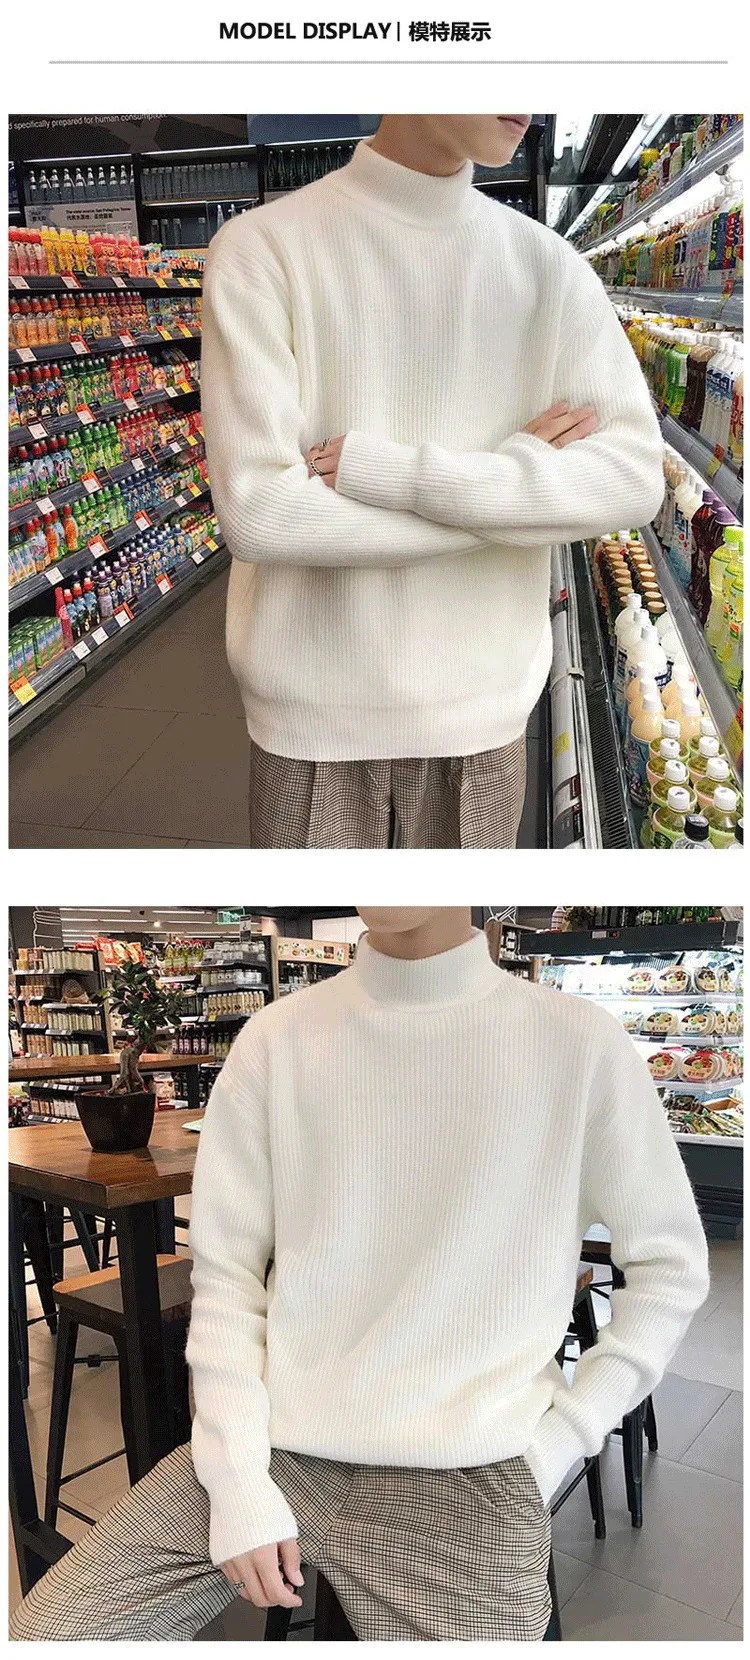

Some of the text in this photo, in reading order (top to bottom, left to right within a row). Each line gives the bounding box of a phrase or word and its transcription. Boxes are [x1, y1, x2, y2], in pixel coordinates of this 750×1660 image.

[14, 120, 50, 130] specifically
[52, 117, 82, 128] prepared
[83, 116, 93, 124] for
[95, 115, 120, 123] human
